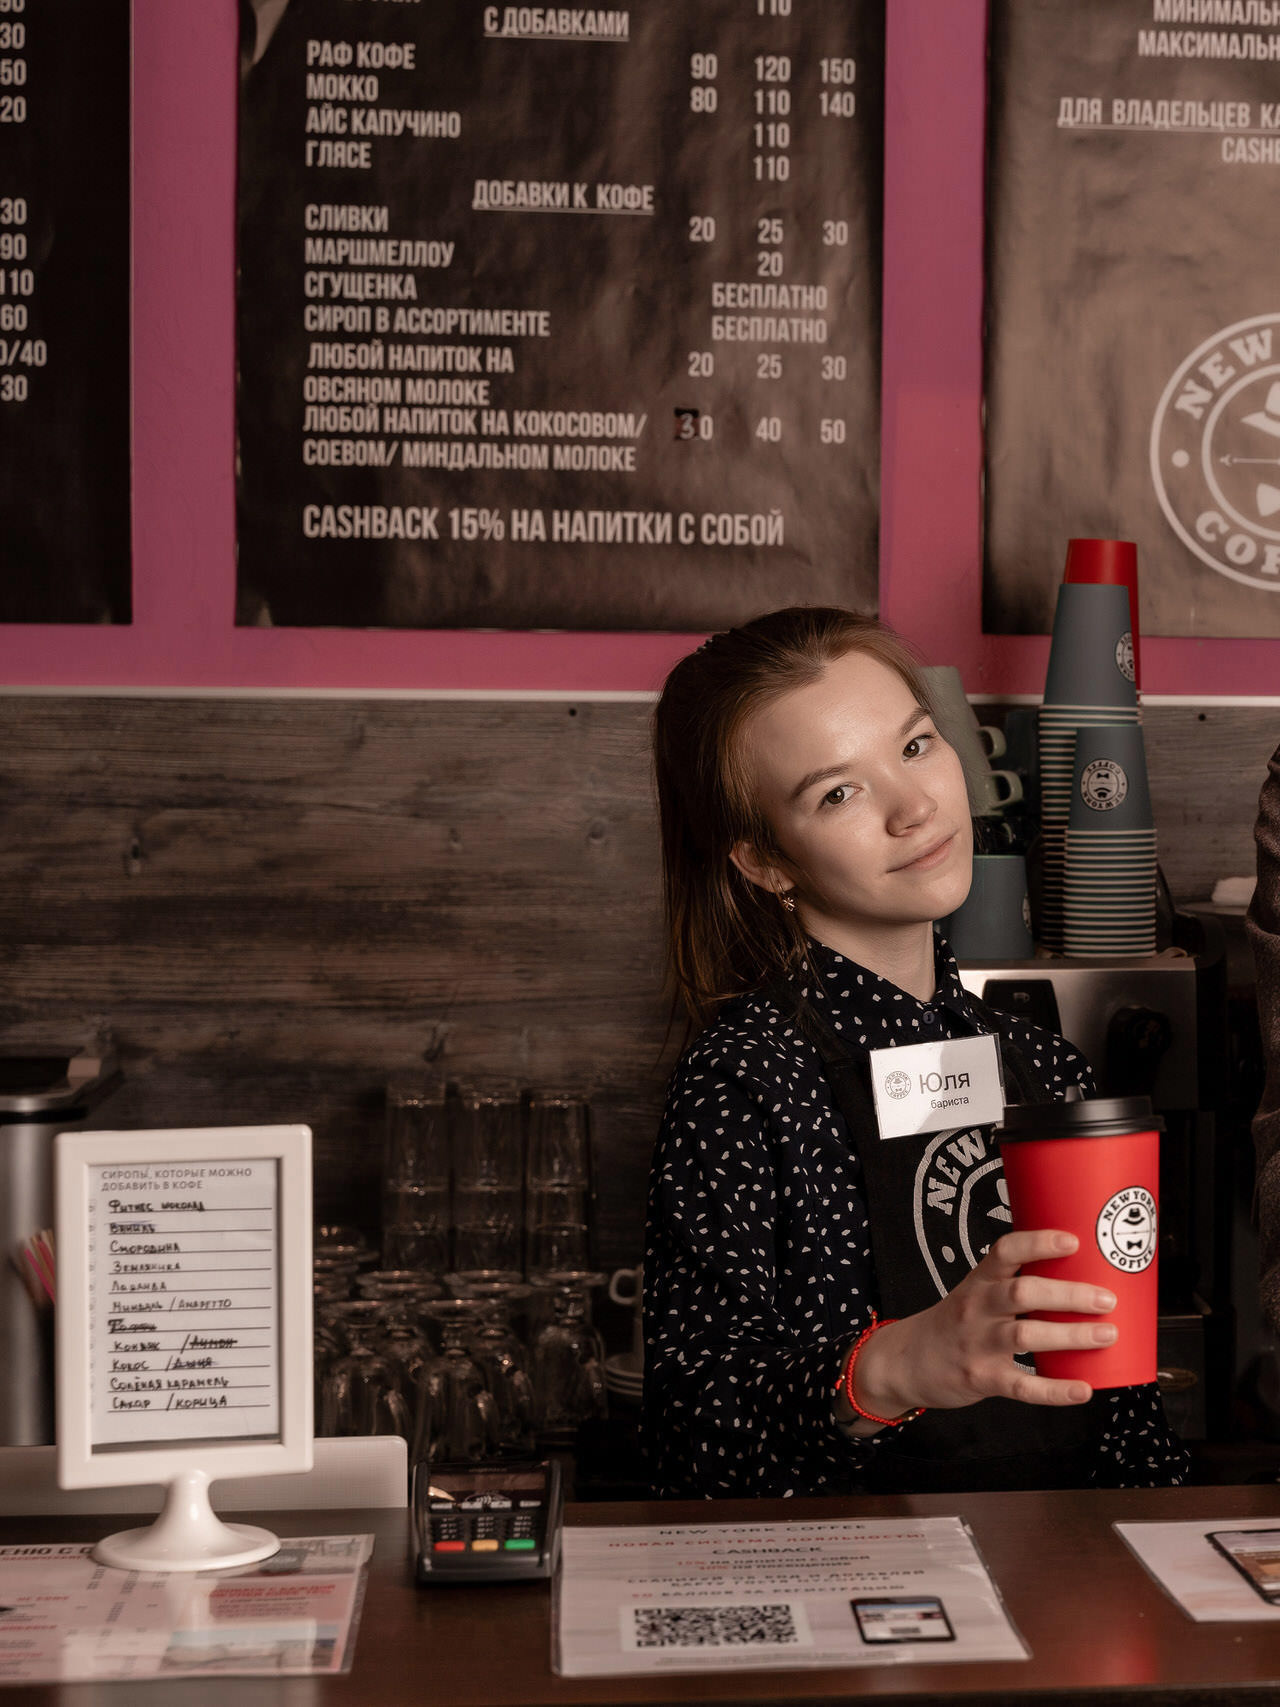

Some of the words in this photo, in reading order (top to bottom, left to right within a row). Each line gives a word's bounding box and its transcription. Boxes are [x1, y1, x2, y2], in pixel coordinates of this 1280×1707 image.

[484, 6, 498, 33] С
[502, 7, 629, 37] ДОБАВКАМИ
[307, 40, 352, 67] РАФ
[356, 41, 416, 70] КОФЕ
[690, 53, 717, 80] 90
[754, 56, 790, 83] 120
[820, 58, 855, 84] 150
[0, 58, 27, 86] 50
[306, 73, 378, 101] МОККО
[0, 96, 26, 122] 20
[690, 87, 717, 112] 80
[754, 89, 790, 115] 110
[819, 92, 855, 117] 140
[1058, 98, 1101, 127] ДЛЯ
[1112, 99, 1251, 130] ВЛАДЕЛЬЦЕВ
[305, 103, 347, 134] АЙС
[351, 109, 461, 138] КАПУЧИНО
[754, 122, 790, 148] 110
[305, 139, 372, 169] ГЛЯСЕ
[753, 155, 789, 181] 110
[472, 180, 568, 210] ДОБАВКИ
[573, 183, 587, 207] К
[597, 184, 655, 210] КОФЕ
[0, 198, 27, 225] 30
[305, 203, 388, 232] СЛИВКИ
[689, 216, 715, 242] 20
[757, 218, 783, 244] 25
[823, 220, 848, 246] 30
[0, 234, 27, 260] 90
[304, 237, 454, 267] МАРШМЕЛЛОУ
[757, 251, 783, 277] 20
[304, 271, 417, 301] СГУЩЕНКА
[711, 282, 828, 311] БЕСПЛАТНО
[1, 305, 27, 331] 60
[304, 304, 371, 332] СИРОП
[376, 308, 390, 332] В
[394, 308, 550, 337] АССОРТИМЕНТЕ
[711, 315, 828, 343] БЕСПЛАТНО
[308, 340, 384, 369] ЛЮБОЙ
[389, 344, 482, 371] НАПИТОК
[487, 346, 514, 373] НА
[688, 352, 714, 377] 20
[756, 354, 782, 379] 25
[821, 356, 847, 380] 30
[1, 375, 28, 401] 30
[1175, 328, 1273, 421] NEW
[304, 376, 401, 403] ОВСЯНОМ
[406, 379, 490, 406] МОЛОКЕ
[303, 402, 378, 433] ЛЮБОЙ
[384, 408, 477, 435] НАПИТОК
[482, 410, 508, 436] НА
[513, 411, 647, 439] КОКОСОВОМ/
[680, 412, 713, 440] 30
[756, 417, 782, 441] 40
[820, 419, 846, 443] 50
[303, 440, 399, 466] СОЕВОМ/
[403, 442, 548, 470] МИНДАЛЬНОМ
[553, 445, 636, 471] МОЛОКЕ
[303, 505, 439, 539] CASHBACK
[448, 509, 504, 541] 15%
[511, 511, 546, 542] НА
[552, 511, 672, 544] НАПИТКИ
[679, 513, 695, 544] С
[701, 509, 784, 546] СОБОЙ
[919, 1072, 971, 1094] Юля
[930, 1096, 970, 1109] бариста
[101, 1181, 160, 1192] ДОБАВИТЬ
[162, 1181, 170, 1190] В
[172, 1180, 203, 1190] КОФЕ
[155, 1168, 206, 1179] КОТОРЫЕ
[208, 1167, 252, 1177] МОЖНО
[927, 1128, 987, 1216] NEW
[1103, 1192, 1130, 1221] NEW
[713, 1546, 822, 1555] CASHBACK
